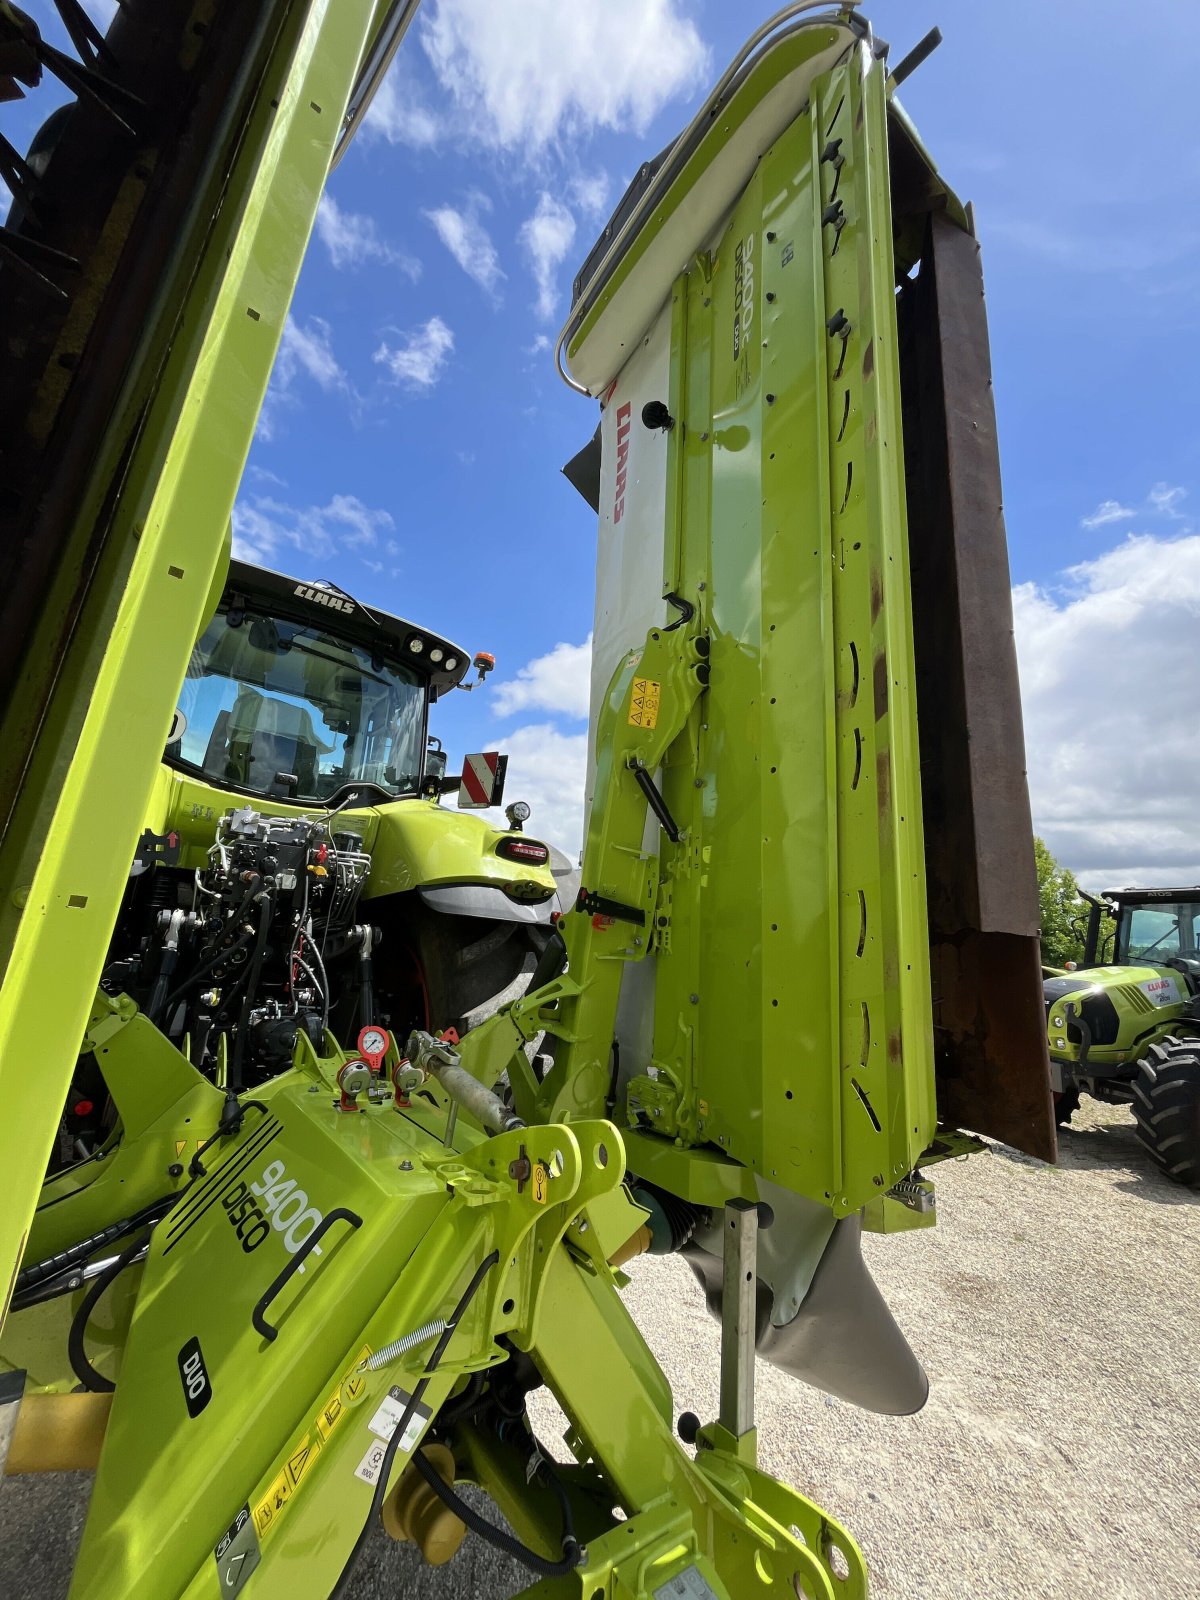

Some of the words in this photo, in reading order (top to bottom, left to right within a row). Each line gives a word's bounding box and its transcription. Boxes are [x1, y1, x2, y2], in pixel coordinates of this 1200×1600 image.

[735, 238, 744, 312] DISCO
[613, 401, 631, 524] CLAAS
[293, 585, 356, 614] CLAAS
[1147, 980, 1170, 992] CLAAS
[221, 1181, 270, 1253] DISCO
[183, 1351, 206, 1400] DUO
